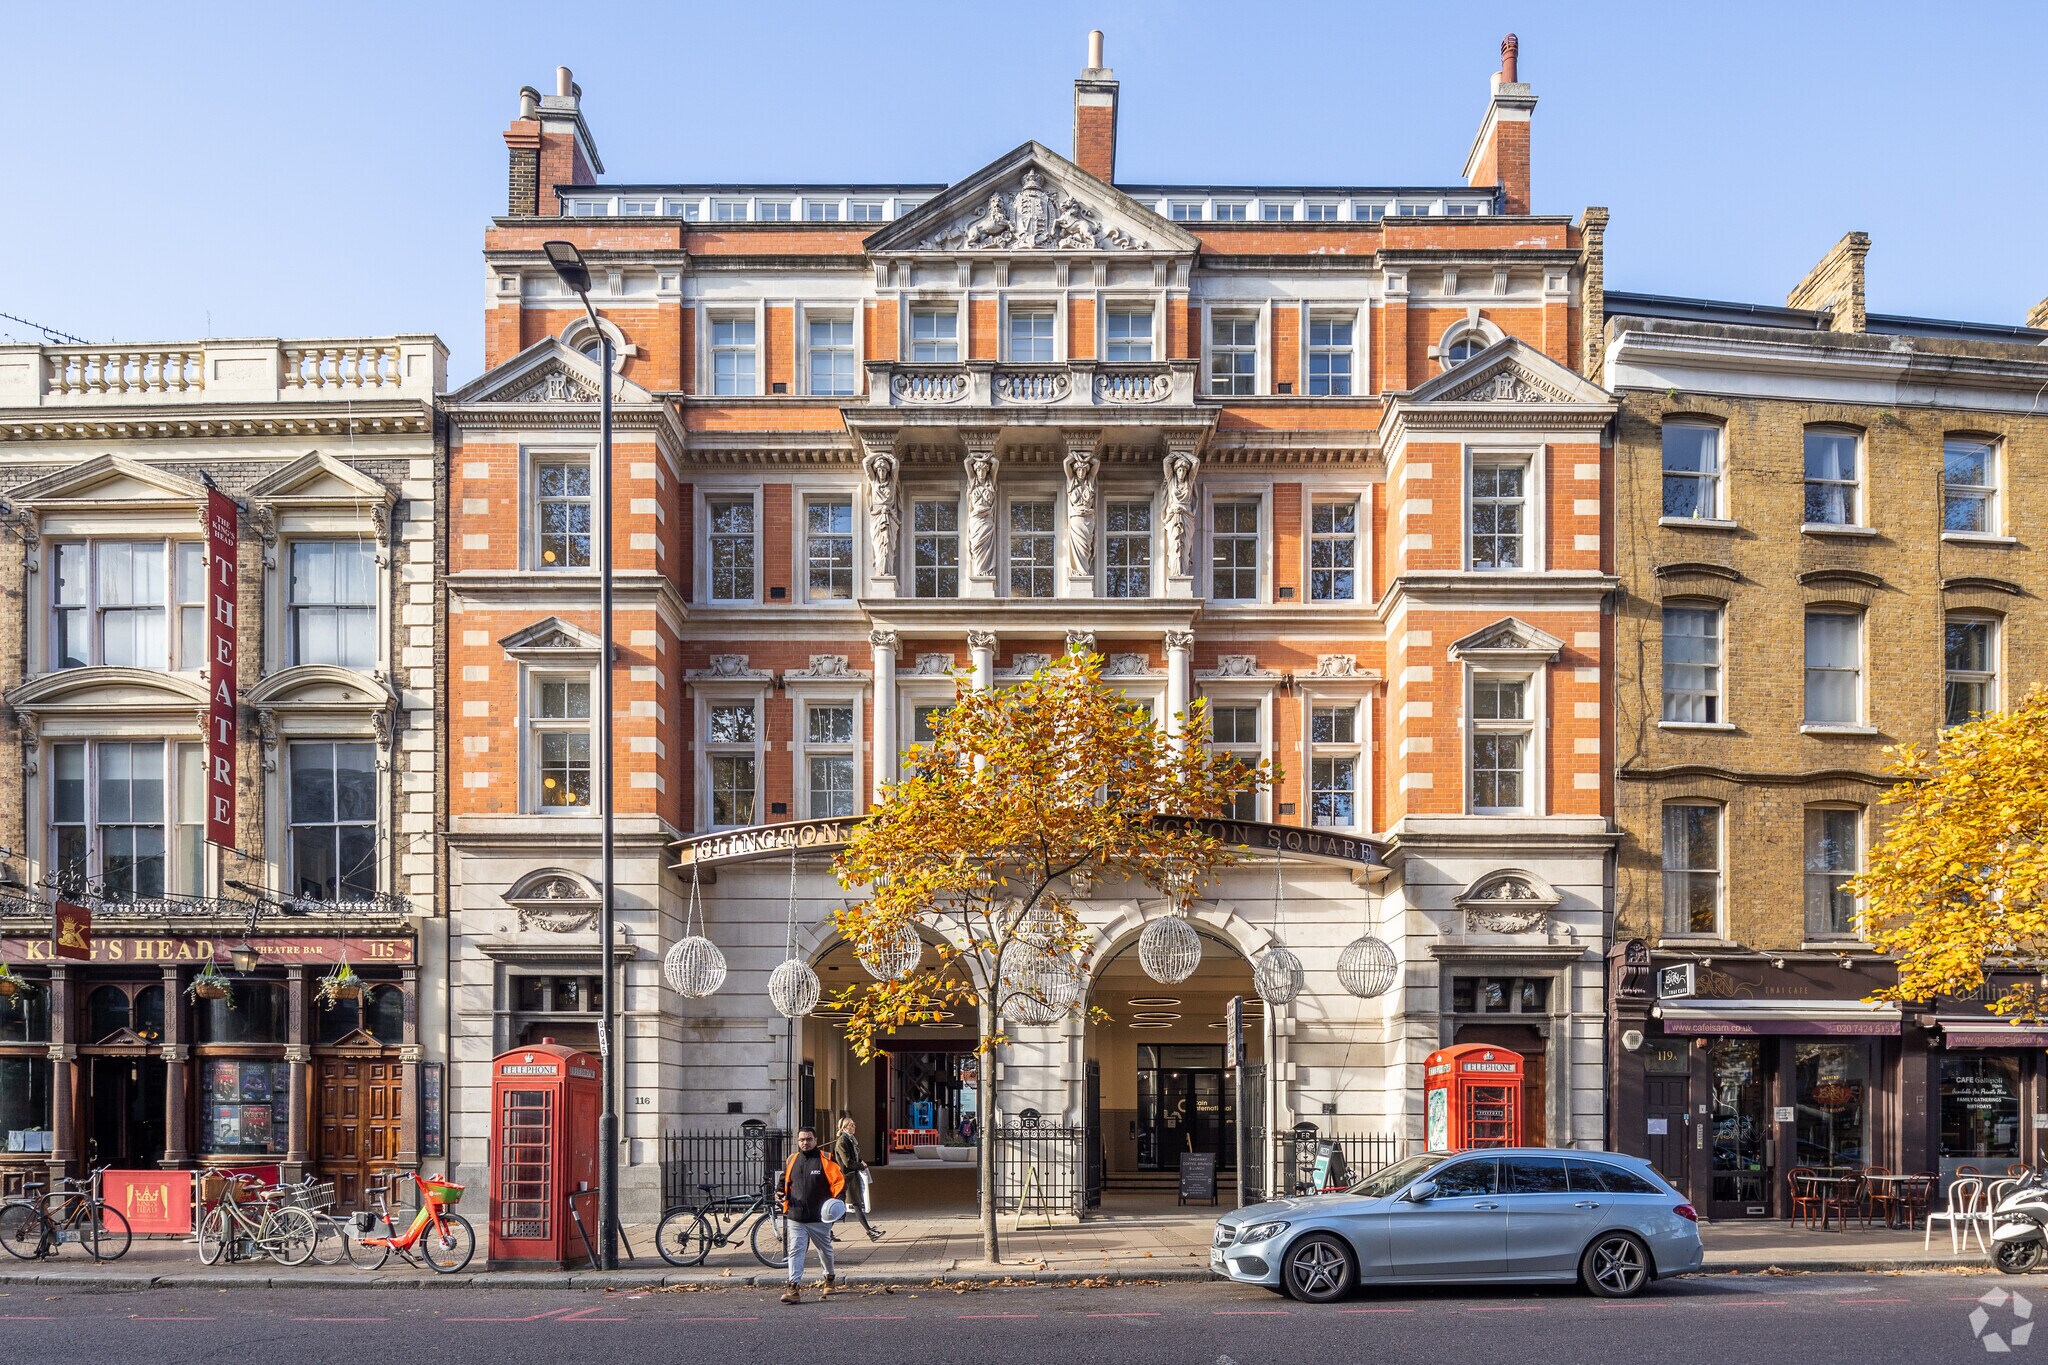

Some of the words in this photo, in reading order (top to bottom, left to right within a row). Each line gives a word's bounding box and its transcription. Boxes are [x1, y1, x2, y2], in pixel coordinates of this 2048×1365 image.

[217, 515, 230, 529] THE
[212, 520, 235, 539] KING'S
[215, 530, 233, 546] HEAD
[213, 555, 234, 825] THEATRE
[691, 822, 840, 862] ISLINGTON
[1267, 829, 1373, 861] SQUARE
[25, 940, 123, 960] KI'S
[134, 940, 214, 960] HEAD
[253, 946, 300, 954] THEATRE
[303, 946, 323, 954] BAR
[370, 943, 394, 957] 115
[1788, 987, 1808, 995] CAFE
[505, 1065, 554, 1074] TELEPHONE
[1465, 1063, 1513, 1072] TELEPHONE
[1974, 1077, 2003, 1085] Gallipoli
